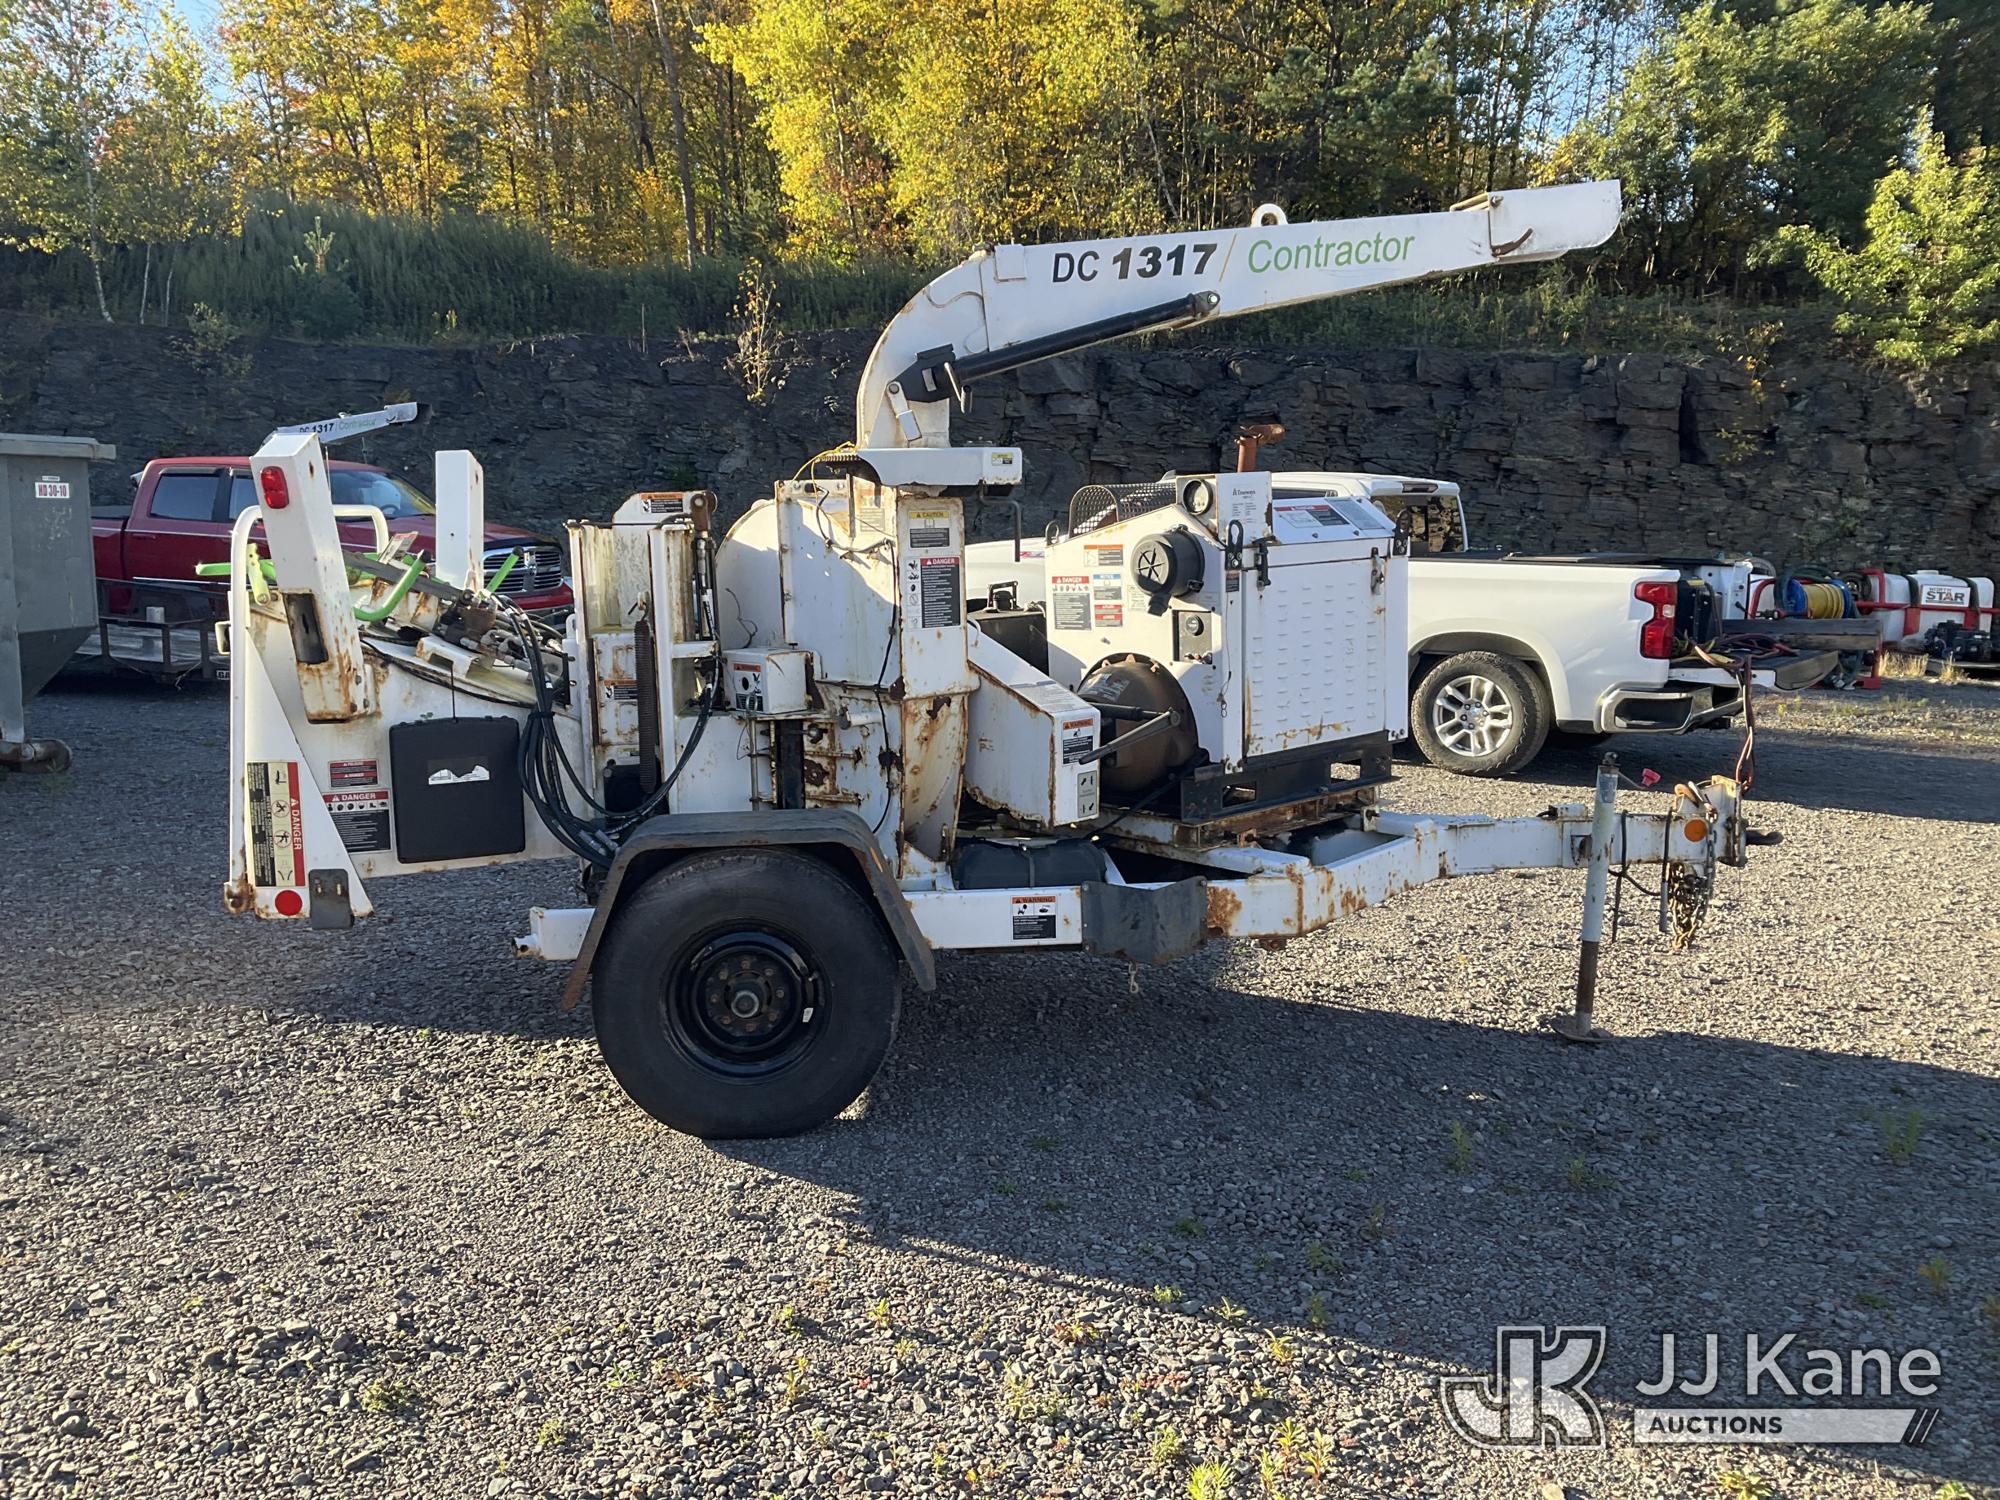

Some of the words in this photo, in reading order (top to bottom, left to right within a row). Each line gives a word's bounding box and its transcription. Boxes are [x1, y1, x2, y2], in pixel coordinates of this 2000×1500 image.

[1052, 251, 1100, 283] DC
[1111, 243, 1218, 280] 1317
[1247, 231, 1415, 273] Contractor
[311, 422, 335, 434] 1317
[48, 484, 67, 497] 30-10
[1926, 591, 1965, 601] STAR
[341, 792, 376, 801] DANGER
[291, 809, 302, 850] DANGER
